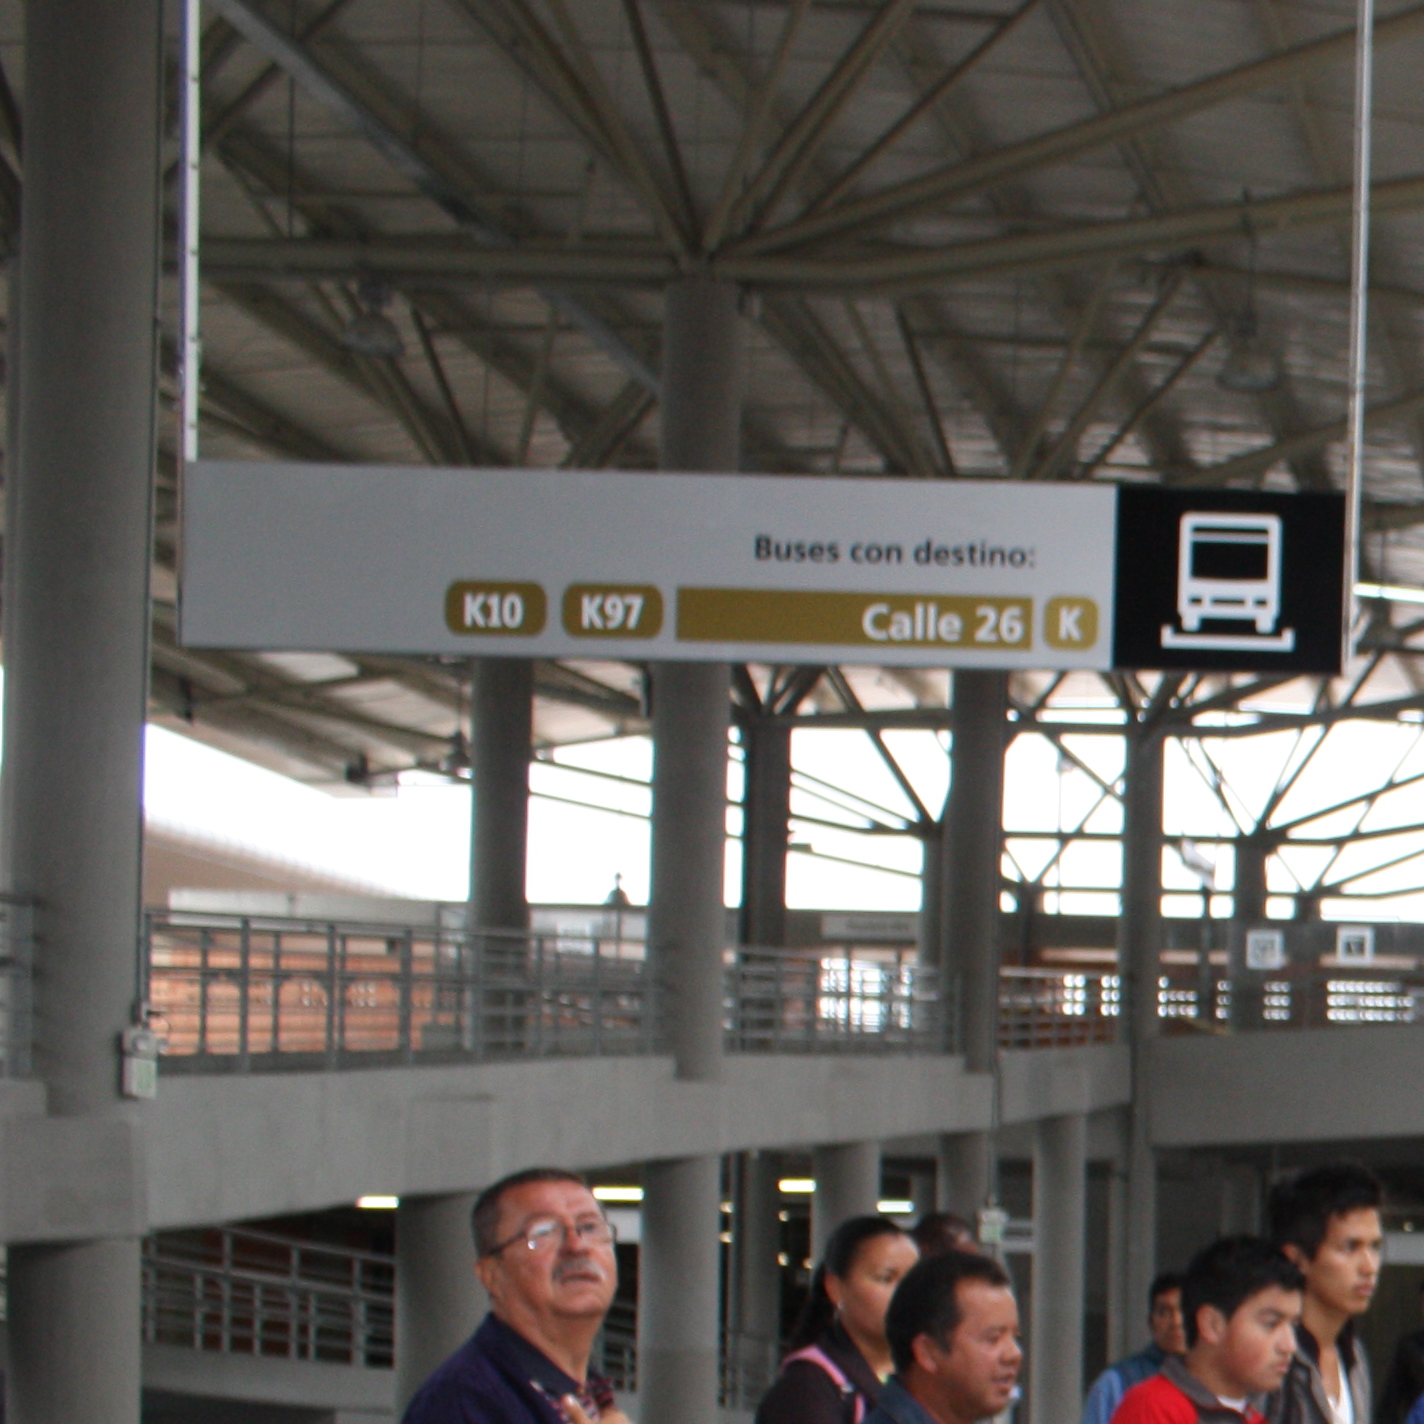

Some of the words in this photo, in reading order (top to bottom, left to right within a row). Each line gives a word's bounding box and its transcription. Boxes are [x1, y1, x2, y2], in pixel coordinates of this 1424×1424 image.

[754, 534, 840, 563] Buses
[850, 543, 903, 566] con
[913, 538, 1037, 569] destino:
[462, 592, 524, 629] K10
[580, 594, 645, 631] K97
[861, 602, 963, 643] Calle
[974, 604, 1025, 644] 26
[1058, 605, 1085, 642] K
